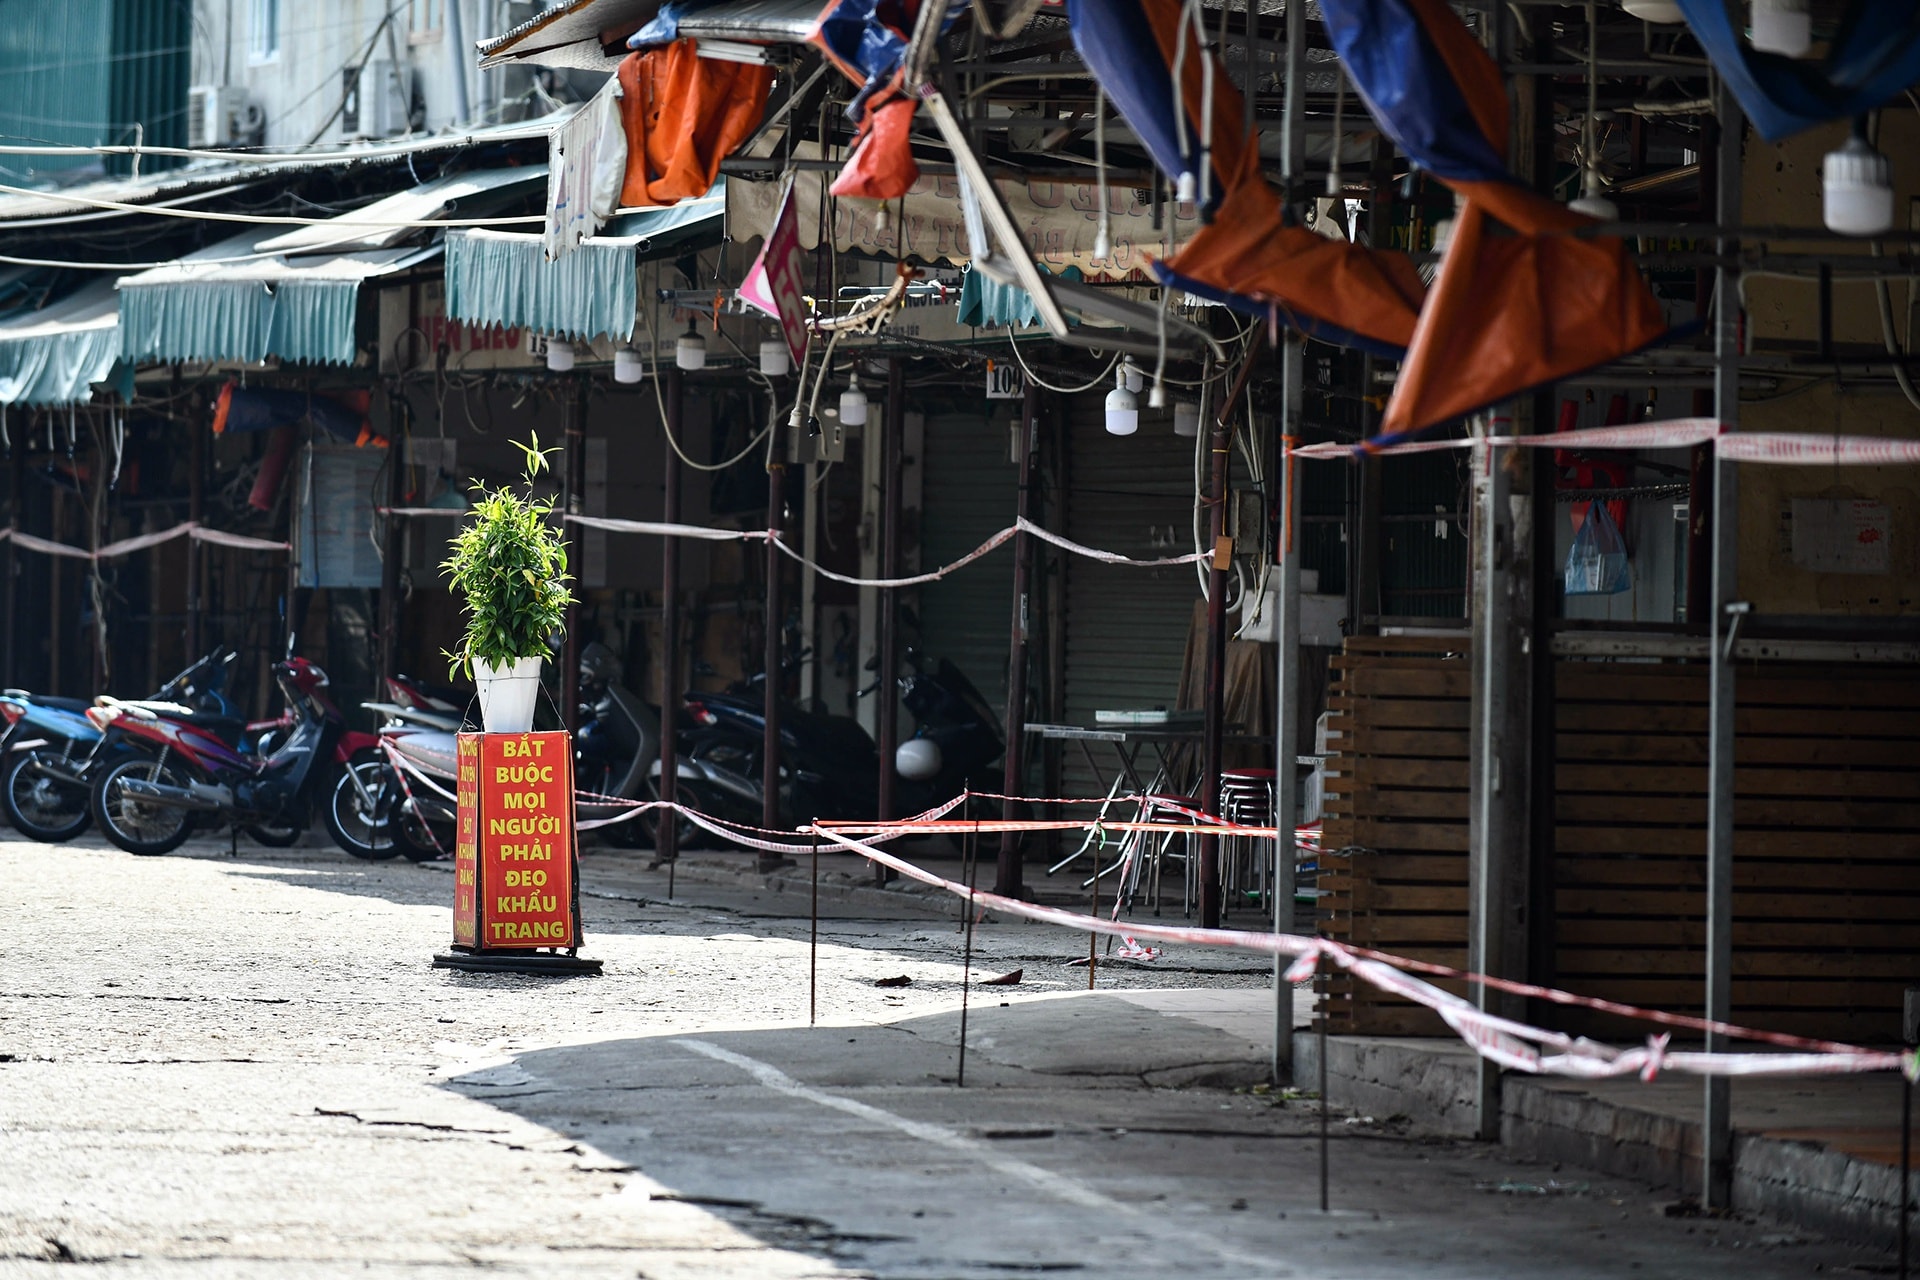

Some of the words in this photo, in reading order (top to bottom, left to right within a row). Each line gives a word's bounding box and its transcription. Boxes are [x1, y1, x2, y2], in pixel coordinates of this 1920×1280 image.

[503, 734, 546, 757] BẮT
[496, 763, 553, 787] BUỘC
[504, 792, 546, 813] MỌI
[490, 813, 561, 835] NGƯỜI
[501, 839, 551, 861] PHẢI
[505, 869, 547, 886] ĐEO
[497, 889, 557, 913] KHẨU
[491, 921, 564, 939] TRANG
